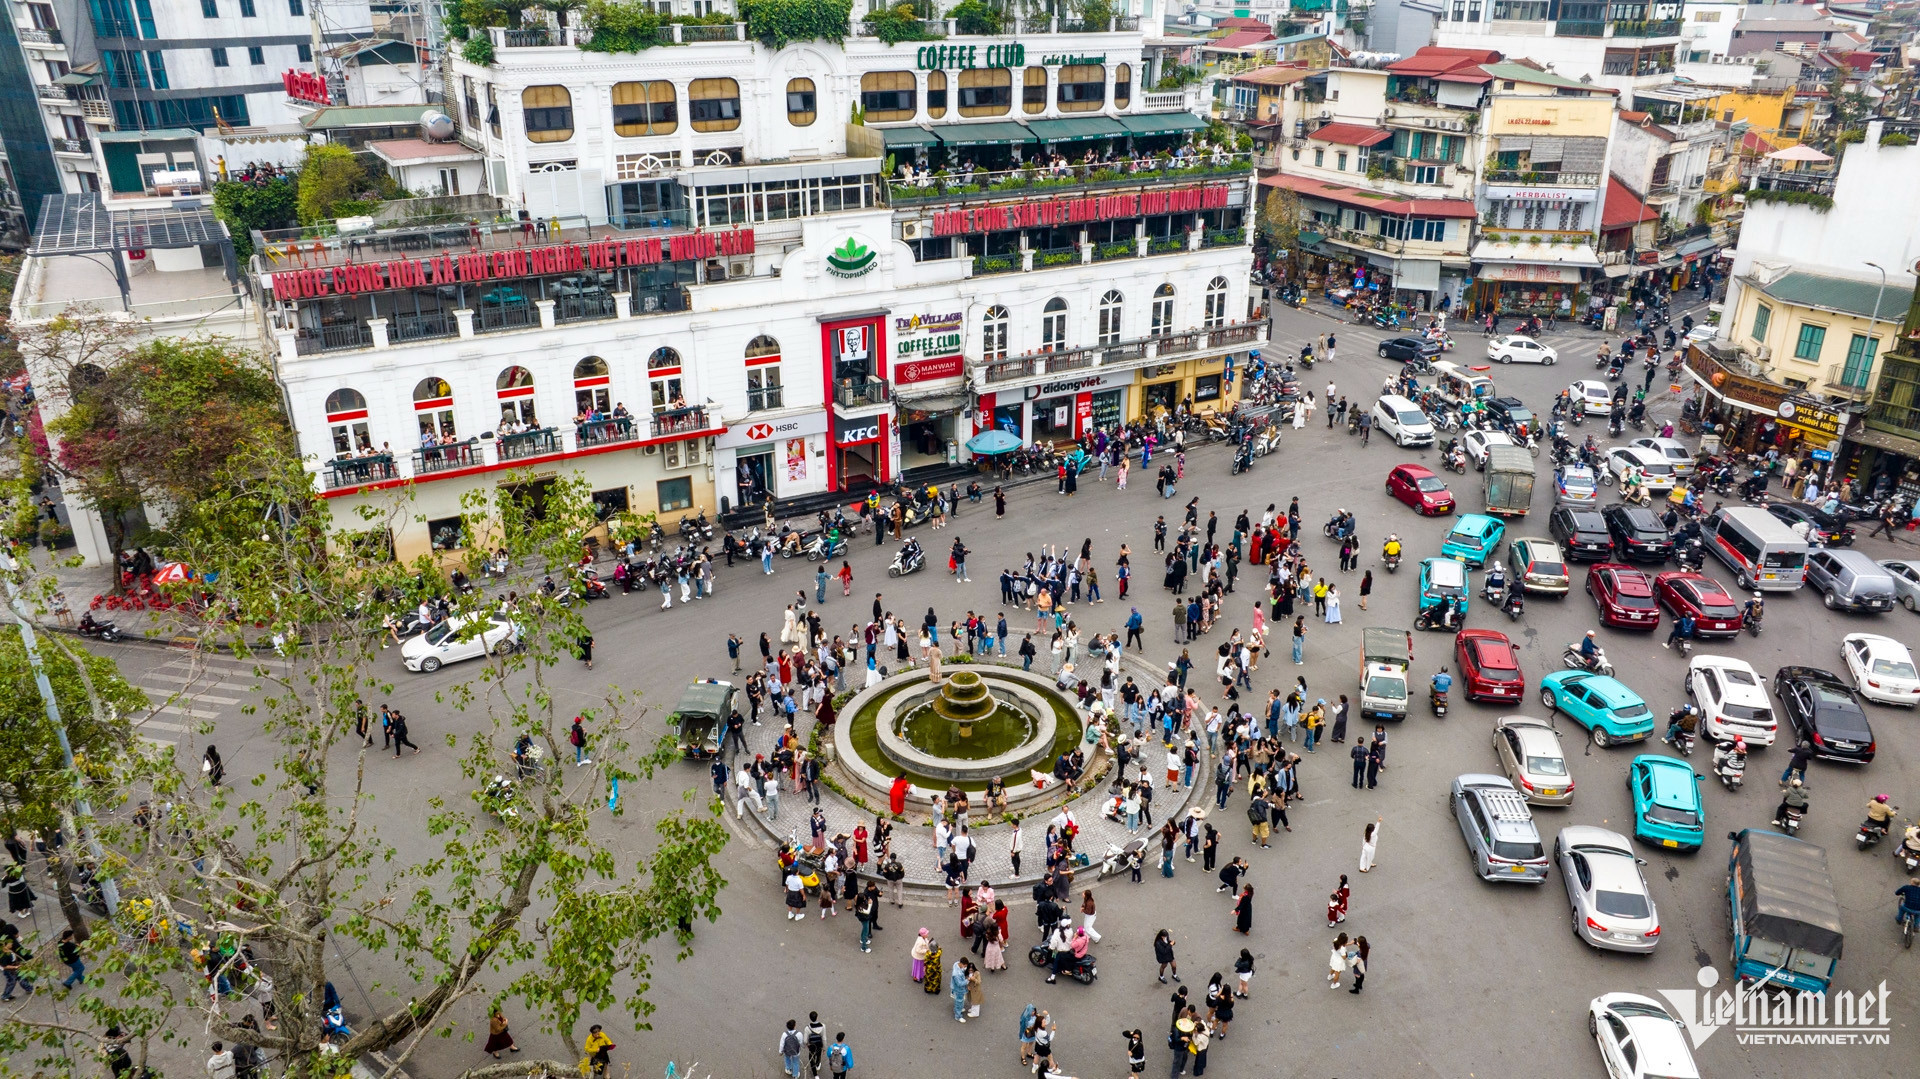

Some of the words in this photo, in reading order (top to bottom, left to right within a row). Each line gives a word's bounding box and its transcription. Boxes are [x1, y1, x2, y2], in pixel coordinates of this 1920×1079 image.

[918, 45, 976, 70] COFFEE
[986, 43, 1025, 69] CLUB
[1516, 191, 1566, 199] HERBALIST
[973, 201, 1008, 236] CỘNG
[1012, 196, 1038, 228] SẢN
[1041, 194, 1066, 229] VIỆT
[1069, 197, 1096, 223] NAM
[1098, 194, 1137, 221] QUANG
[1141, 191, 1167, 215] VINH
[1168, 184, 1201, 212] MUÔN
[1202, 181, 1228, 209] NĂM
[272, 261, 328, 300] NƯỚC
[332, 258, 385, 299] CỘNG
[388, 252, 426, 288] HÒA
[429, 250, 456, 286] XÃ
[458, 246, 489, 287] HỘI
[493, 240, 527, 279] CHỦ
[531, 239, 584, 276] NGHĨA
[588, 234, 622, 273] VIỆT
[626, 238, 662, 265] NAM
[669, 227, 716, 261] MUÔN
[721, 223, 755, 256] NĂM
[825, 261, 878, 279] PHYTOPHARCO
[898, 337, 933, 354] COFFEE
[937, 334, 960, 348] CLUB
[921, 362, 956, 372] MANWAH
[1796, 405, 1813, 415] PATE
[1814, 410, 1829, 422] CT
[775, 423, 799, 433] HSBC
[1798, 415, 1819, 427] CHÍNH
[1820, 422, 1837, 432] HIỆU
[843, 425, 878, 444] KFC
